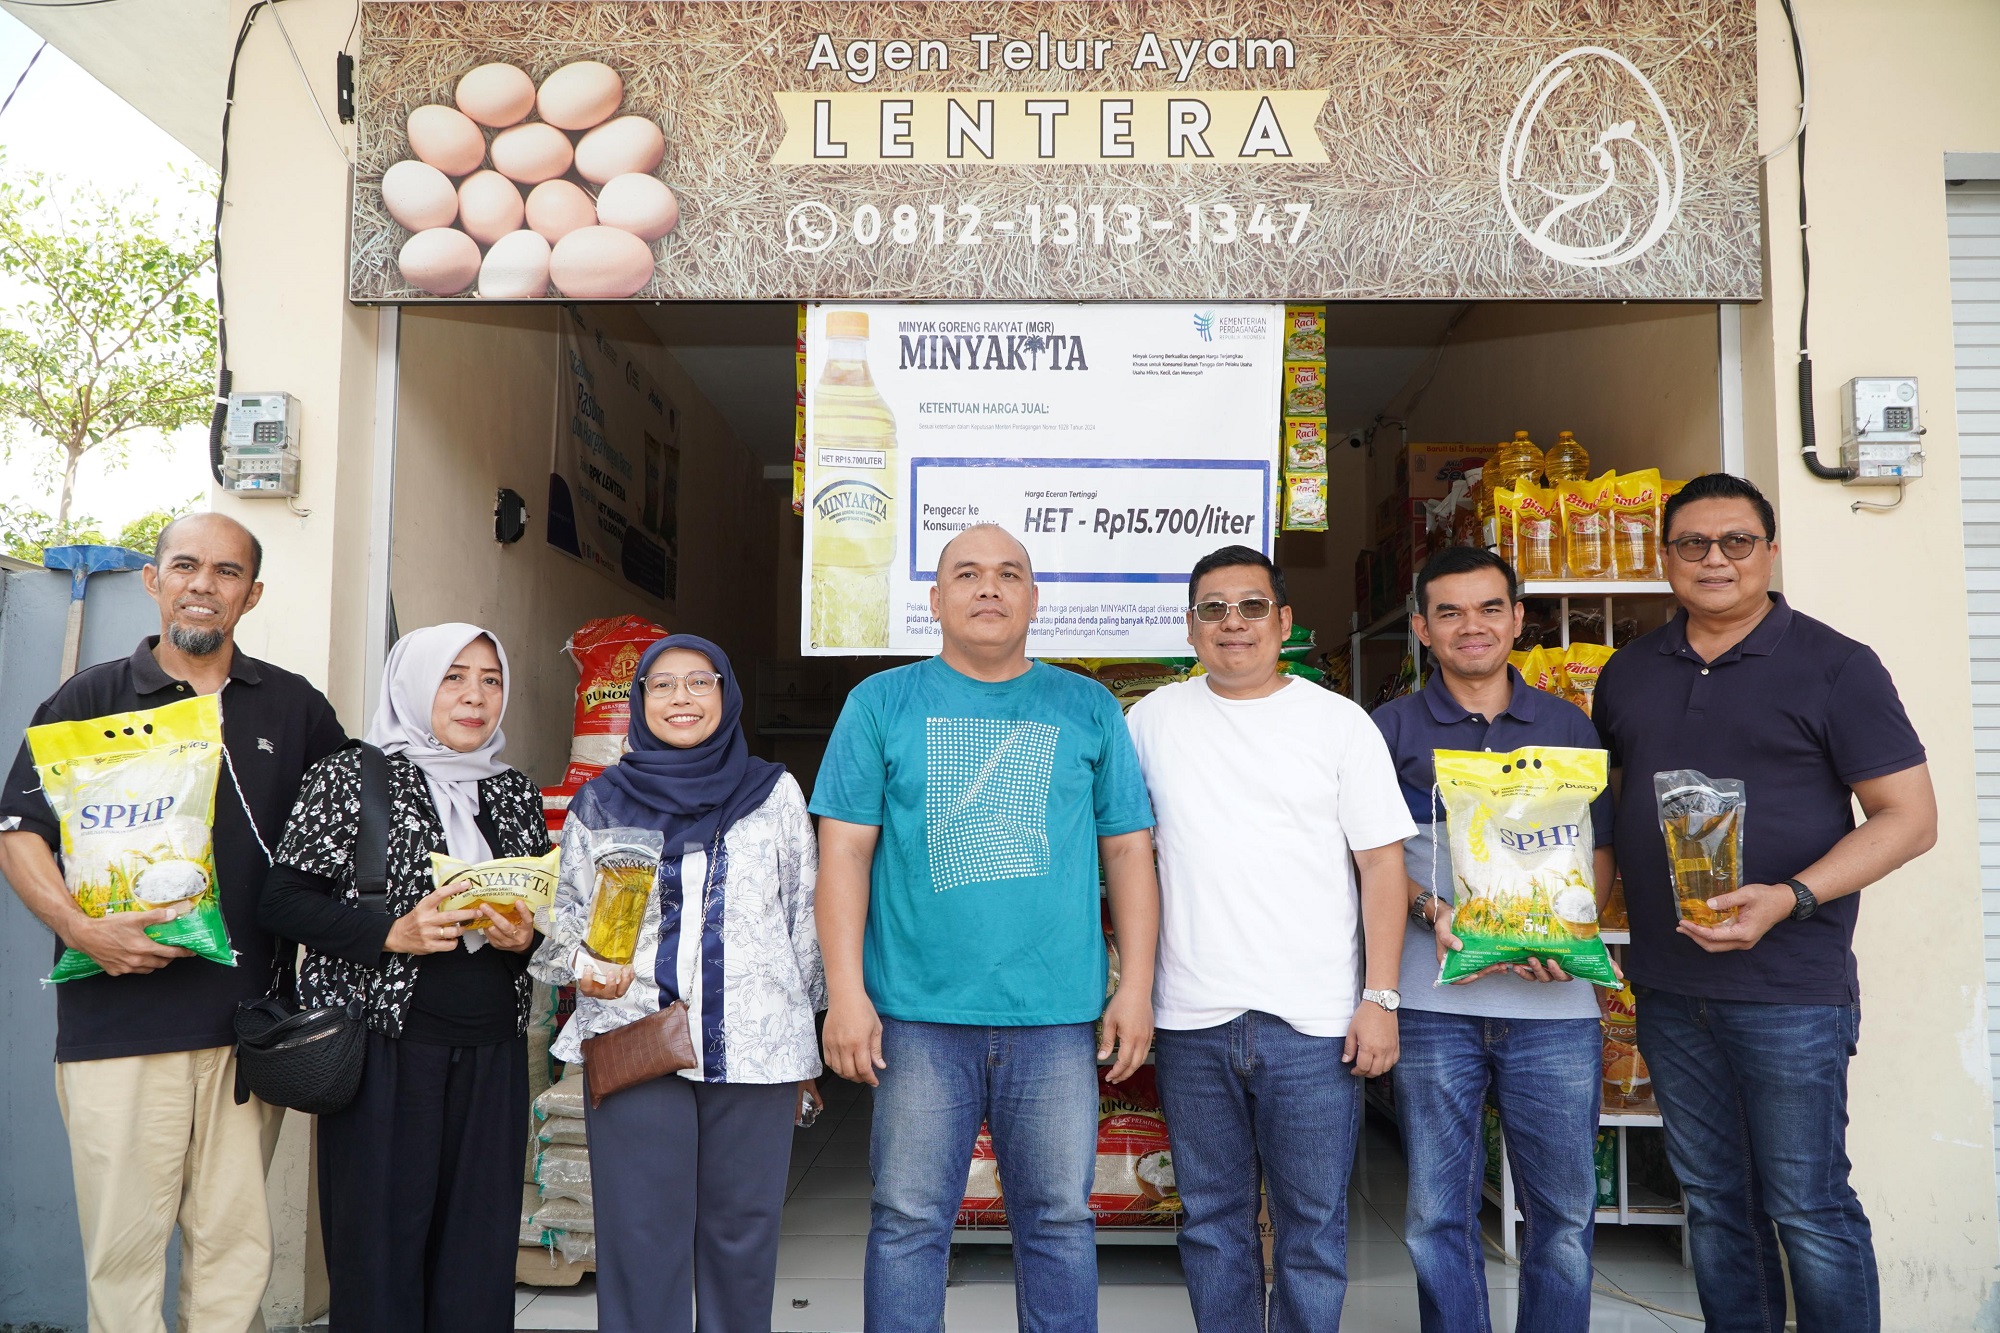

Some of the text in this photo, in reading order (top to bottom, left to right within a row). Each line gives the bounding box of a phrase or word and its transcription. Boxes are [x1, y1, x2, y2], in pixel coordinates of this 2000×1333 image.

[806, 32, 1296, 84] Agen Telur Ayam
[813, 96, 1293, 159] LENTERA
[853, 203, 1314, 246] 0812-1313-1347
[898, 322, 1054, 335] MINYAK GORENG RAKYAT (MGR)
[1294, 318, 1318, 328] Racik
[1294, 372, 1318, 384] Racik
[920, 402, 1049, 414] KETENTUAN HARGA JUAL:
[1296, 428, 1319, 439] Racik
[821, 454, 833, 463] HET
[1069, 491, 1098, 499] Tertinggi
[1613, 488, 1653, 506] imoli
[923, 504, 979, 517] Pengecer ke
[923, 520, 972, 531] Konsumen
[1024, 507, 1073, 533] HET
[1093, 504, 1255, 539] Rp15.700/liter
[906, 602, 928, 611] Pelaku
[1050, 604, 1067, 614] harga
[1069, 604, 1098, 614] penjualan
[1138, 605, 1155, 614] dapat
[906, 614, 928, 624] pidana
[1054, 616, 1076, 625] pidana
[1078, 616, 1098, 624] denda
[1100, 616, 1119, 626] paling
[1120, 616, 1143, 626] banyak
[1145, 616, 1186, 626] Rp2.000.000.
[906, 626, 923, 634] Pasal
[925, 626, 932, 634] 62
[1031, 628, 1054, 637] tentang
[1055, 627, 1095, 638] Perlindungan
[1097, 628, 1129, 636] Konsumen
[586, 689, 631, 705] PUNOK
[1565, 783, 1598, 792] bulog
[80, 796, 175, 830] SPHP
[1500, 824, 1580, 850] SPHP
[1523, 919, 1548, 934] 5 kg
